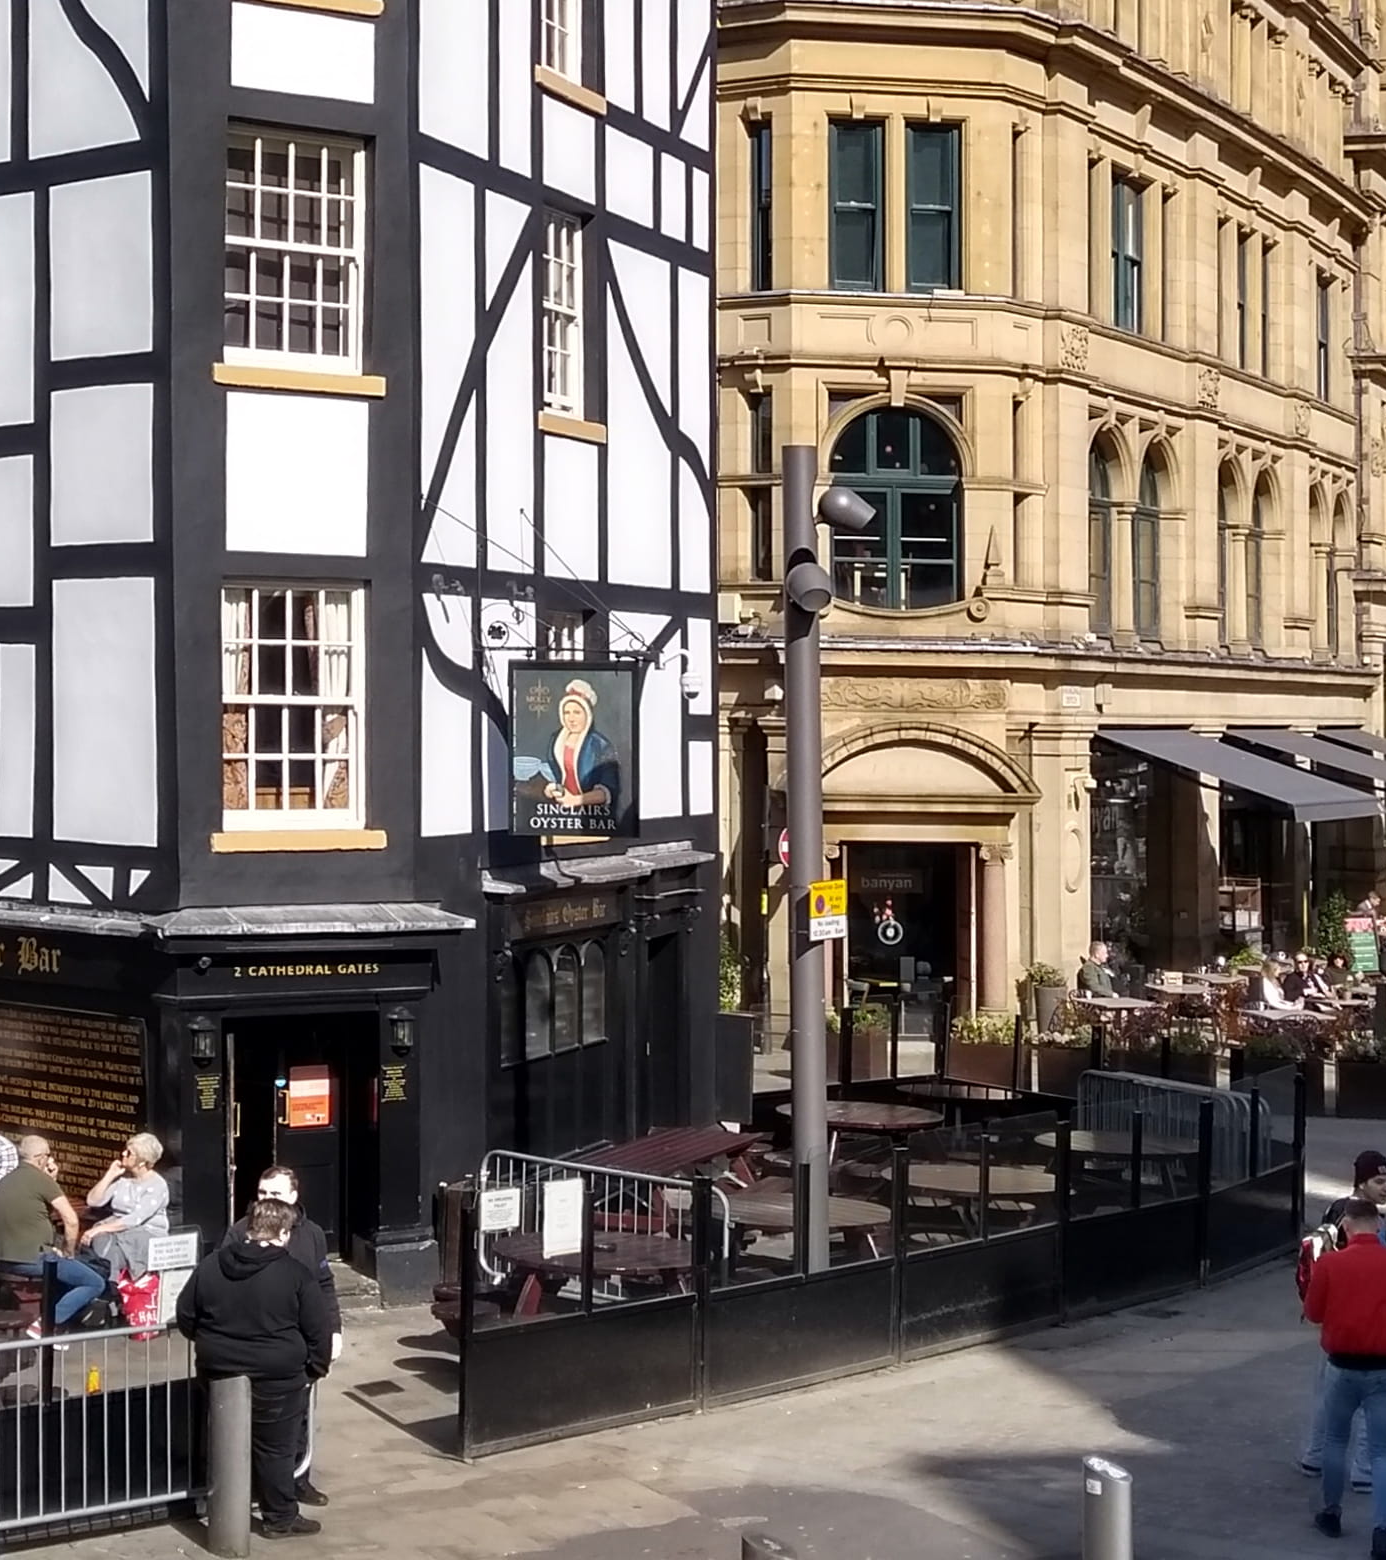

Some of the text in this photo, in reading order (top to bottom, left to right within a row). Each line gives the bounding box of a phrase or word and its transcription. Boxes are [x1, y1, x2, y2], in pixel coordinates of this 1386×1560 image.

[536, 803, 611, 816] SINCLAIR'S
[529, 816, 616, 830] OYSTER BAR
[861, 876, 913, 894] banyan
[18, 936, 62, 975] Bar
[233, 963, 380, 978] 2 CATHEDRAL GATES
